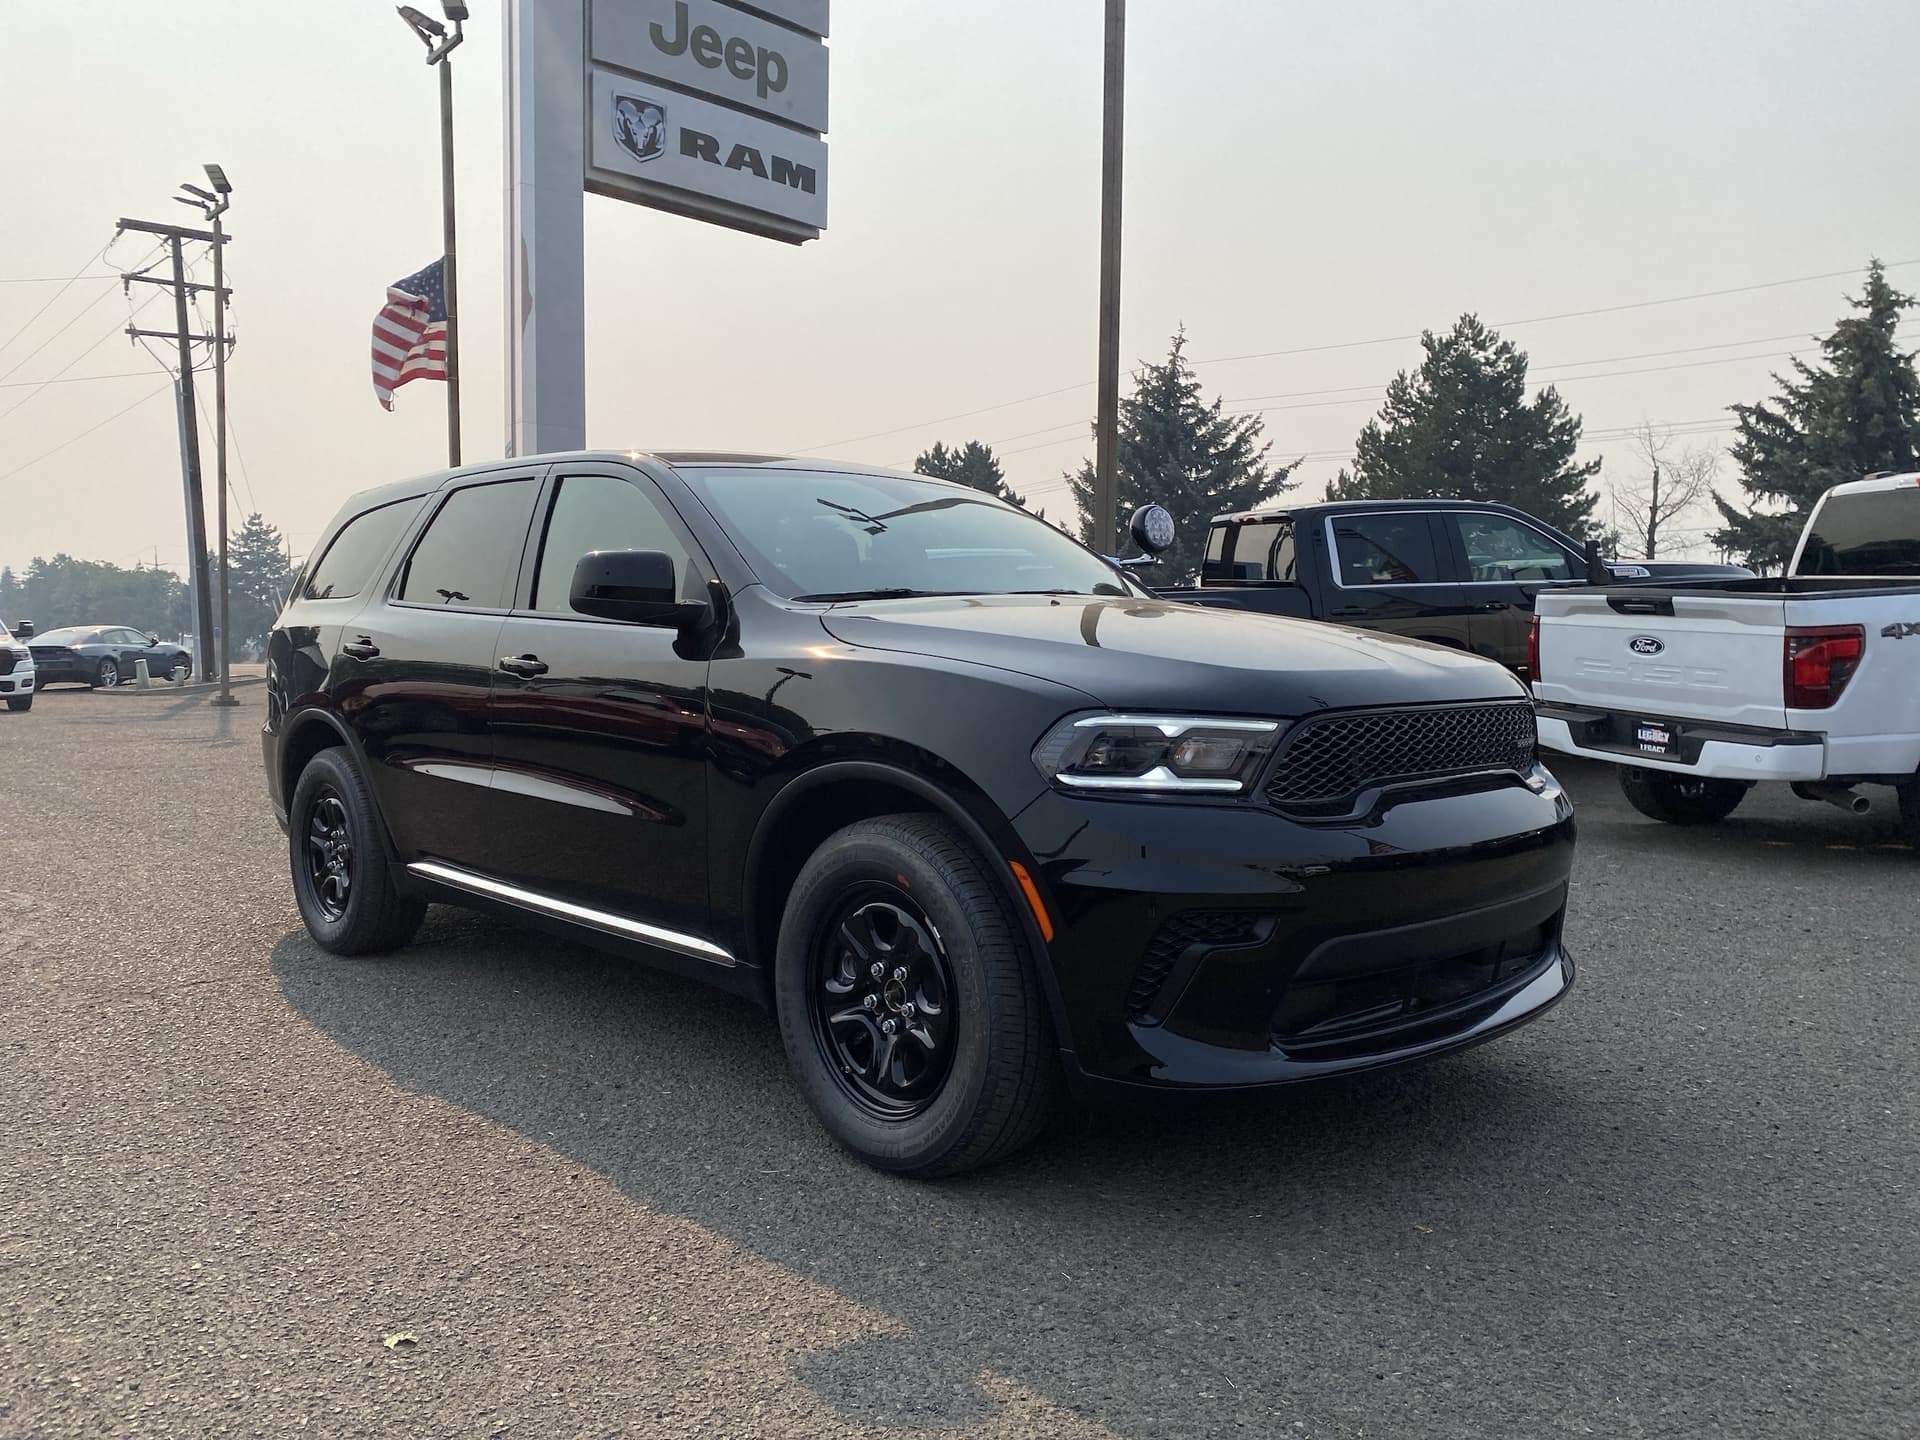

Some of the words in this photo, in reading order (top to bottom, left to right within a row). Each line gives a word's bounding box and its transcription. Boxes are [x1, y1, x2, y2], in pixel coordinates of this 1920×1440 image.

[650, 1, 788, 100] Jeep
[680, 127, 816, 195] RAM
[1633, 638, 1658, 652] Ford
